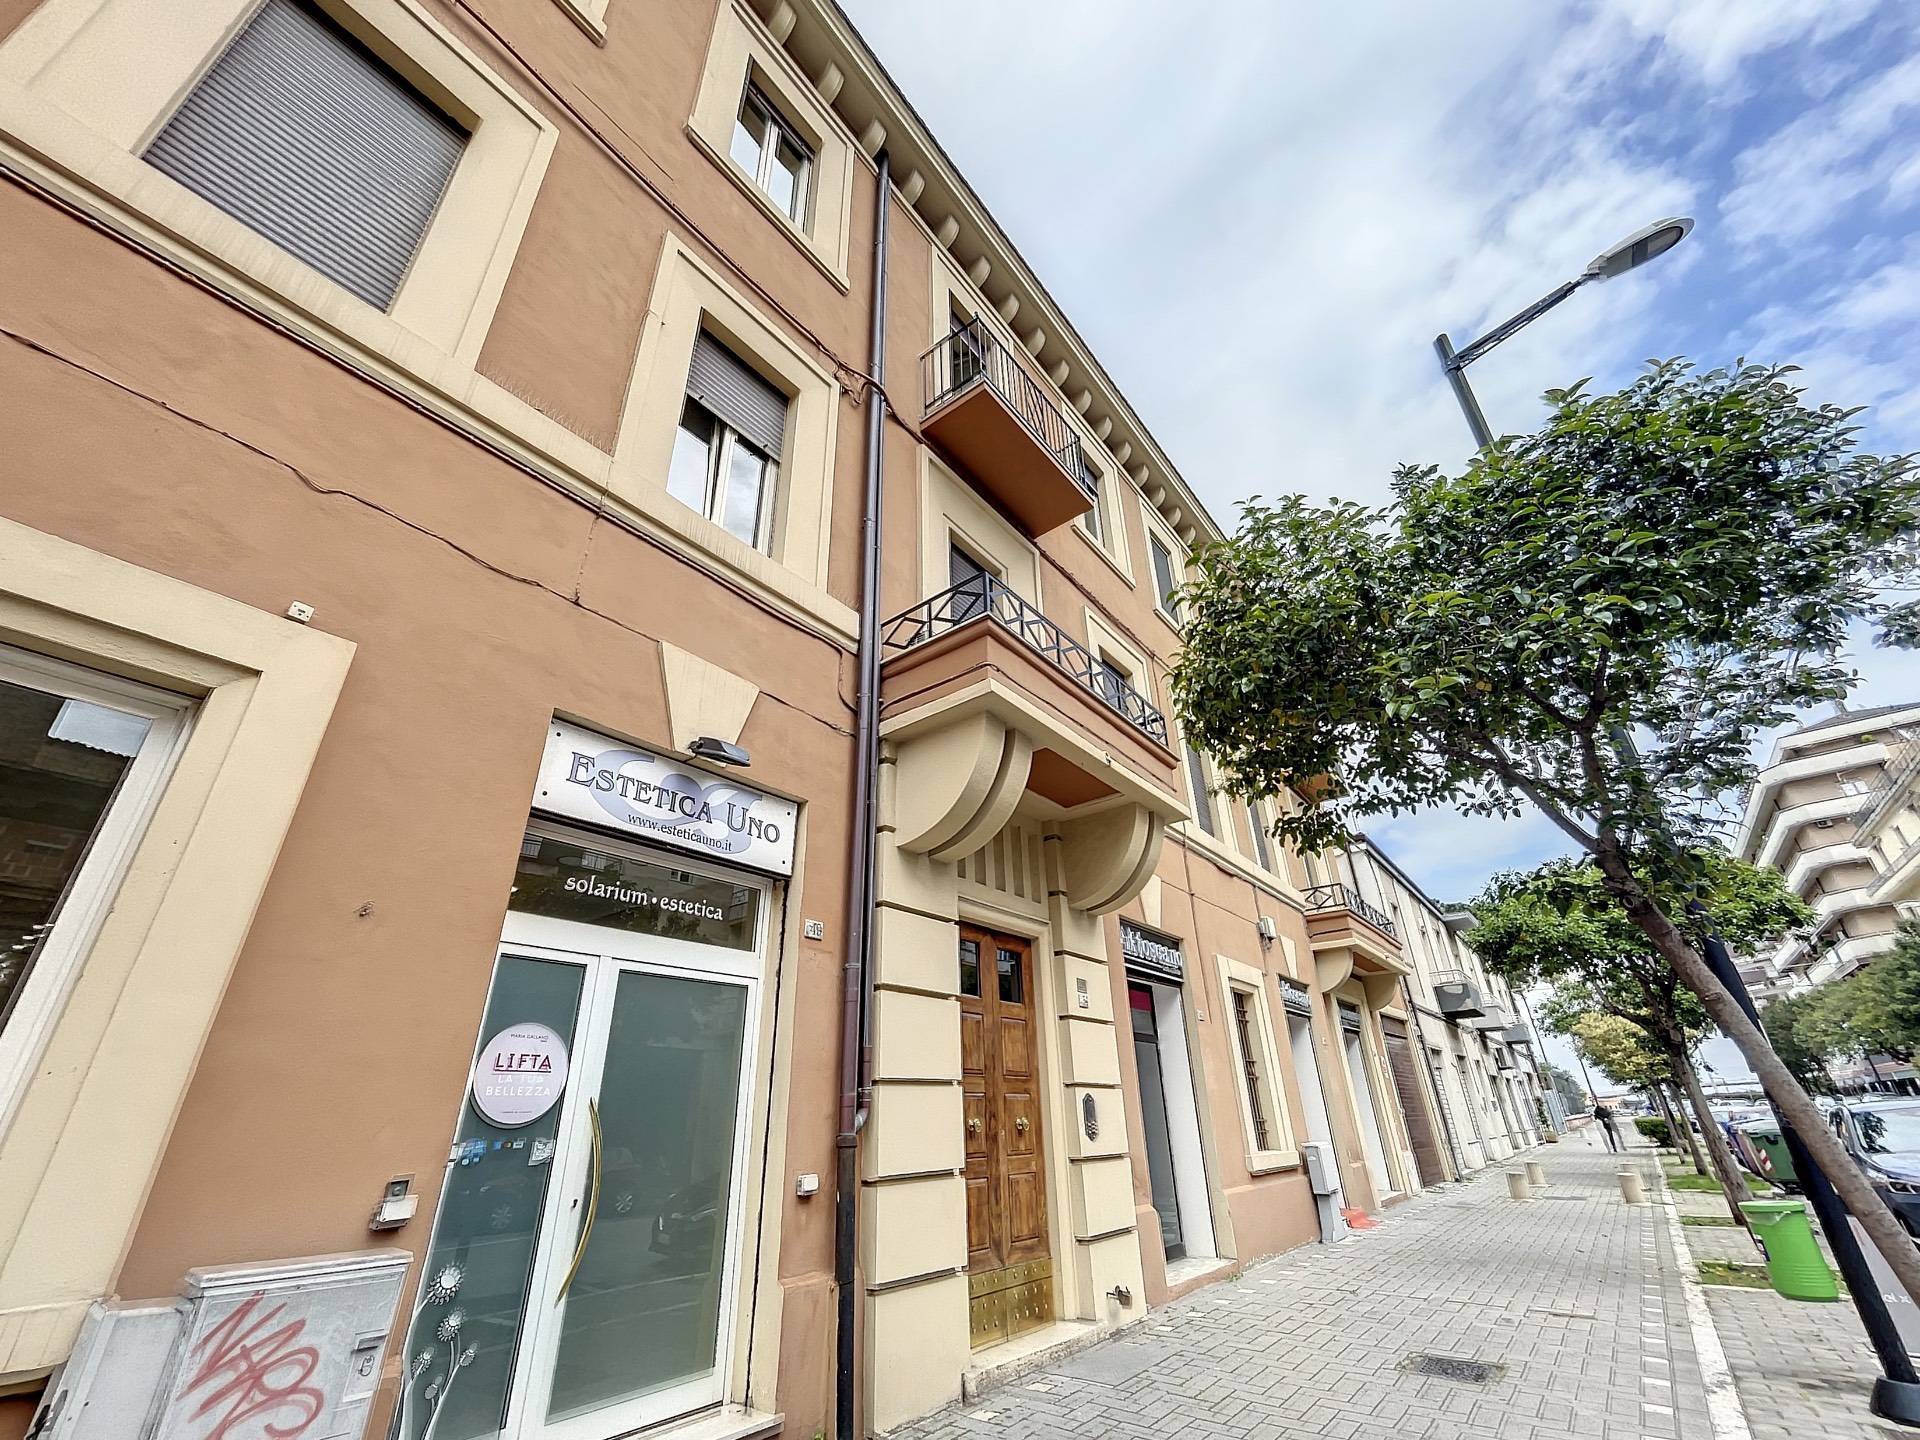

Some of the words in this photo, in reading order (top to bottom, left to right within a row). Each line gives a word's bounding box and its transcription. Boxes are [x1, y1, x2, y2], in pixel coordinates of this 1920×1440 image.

[627, 812, 733, 852] www.esteticauno.it
[564, 873, 649, 906] solarium
[659, 896, 724, 921] estetica
[494, 1052, 552, 1070] LIFTA
[485, 1085, 551, 1097] BELLEZZA
